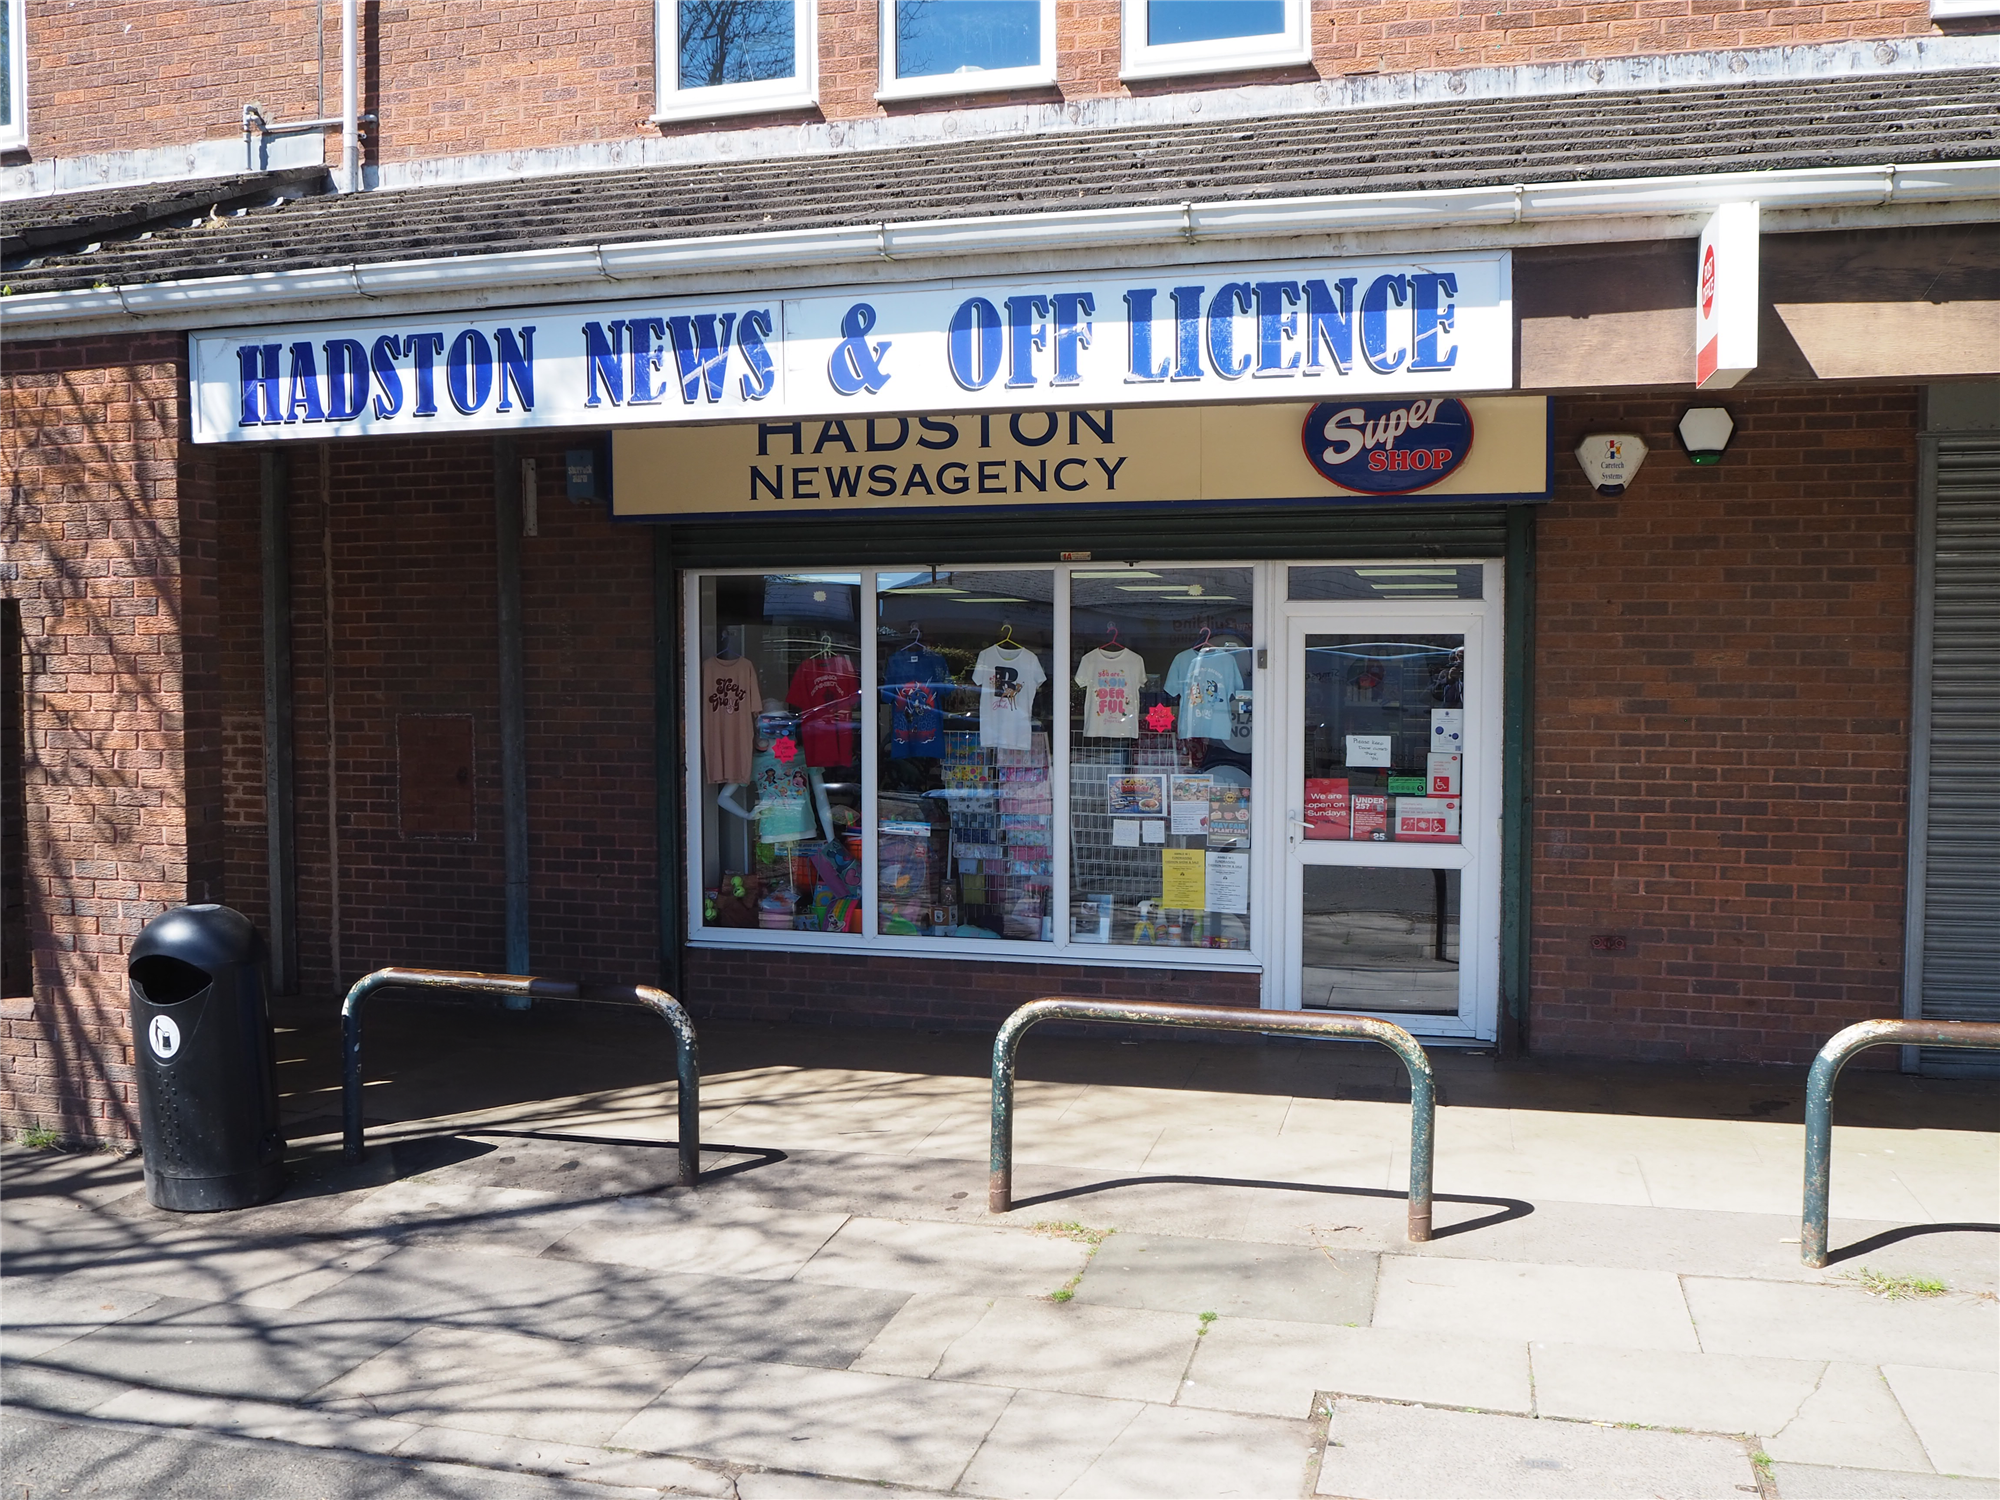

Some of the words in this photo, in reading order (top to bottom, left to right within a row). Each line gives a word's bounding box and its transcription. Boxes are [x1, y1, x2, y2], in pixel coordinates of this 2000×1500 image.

[1704, 256, 1713, 284] POST
[1702, 276, 1714, 306] OFFICE
[237, 326, 537, 427] HADSTON
[582, 309, 775, 408] NEWS
[827, 302, 893, 396] &
[947, 291, 1096, 391] OFF
[1123, 273, 1459, 384] LICENCE
[756, 409, 1115, 457] HADSTON
[1323, 398, 1445, 466] Super
[1368, 448, 1453, 472] SHOP
[1600, 461, 1625, 469] Caretech
[749, 456, 1129, 501] NEWSAGENCY
[1601, 472, 1623, 482] Systems
[1098, 678, 1125, 688] WON
[1098, 688, 1124, 699] DER
[1099, 699, 1126, 714] FUL
[1231, 726, 1252, 738] NO
[1307, 809, 1347, 818] Sundays
